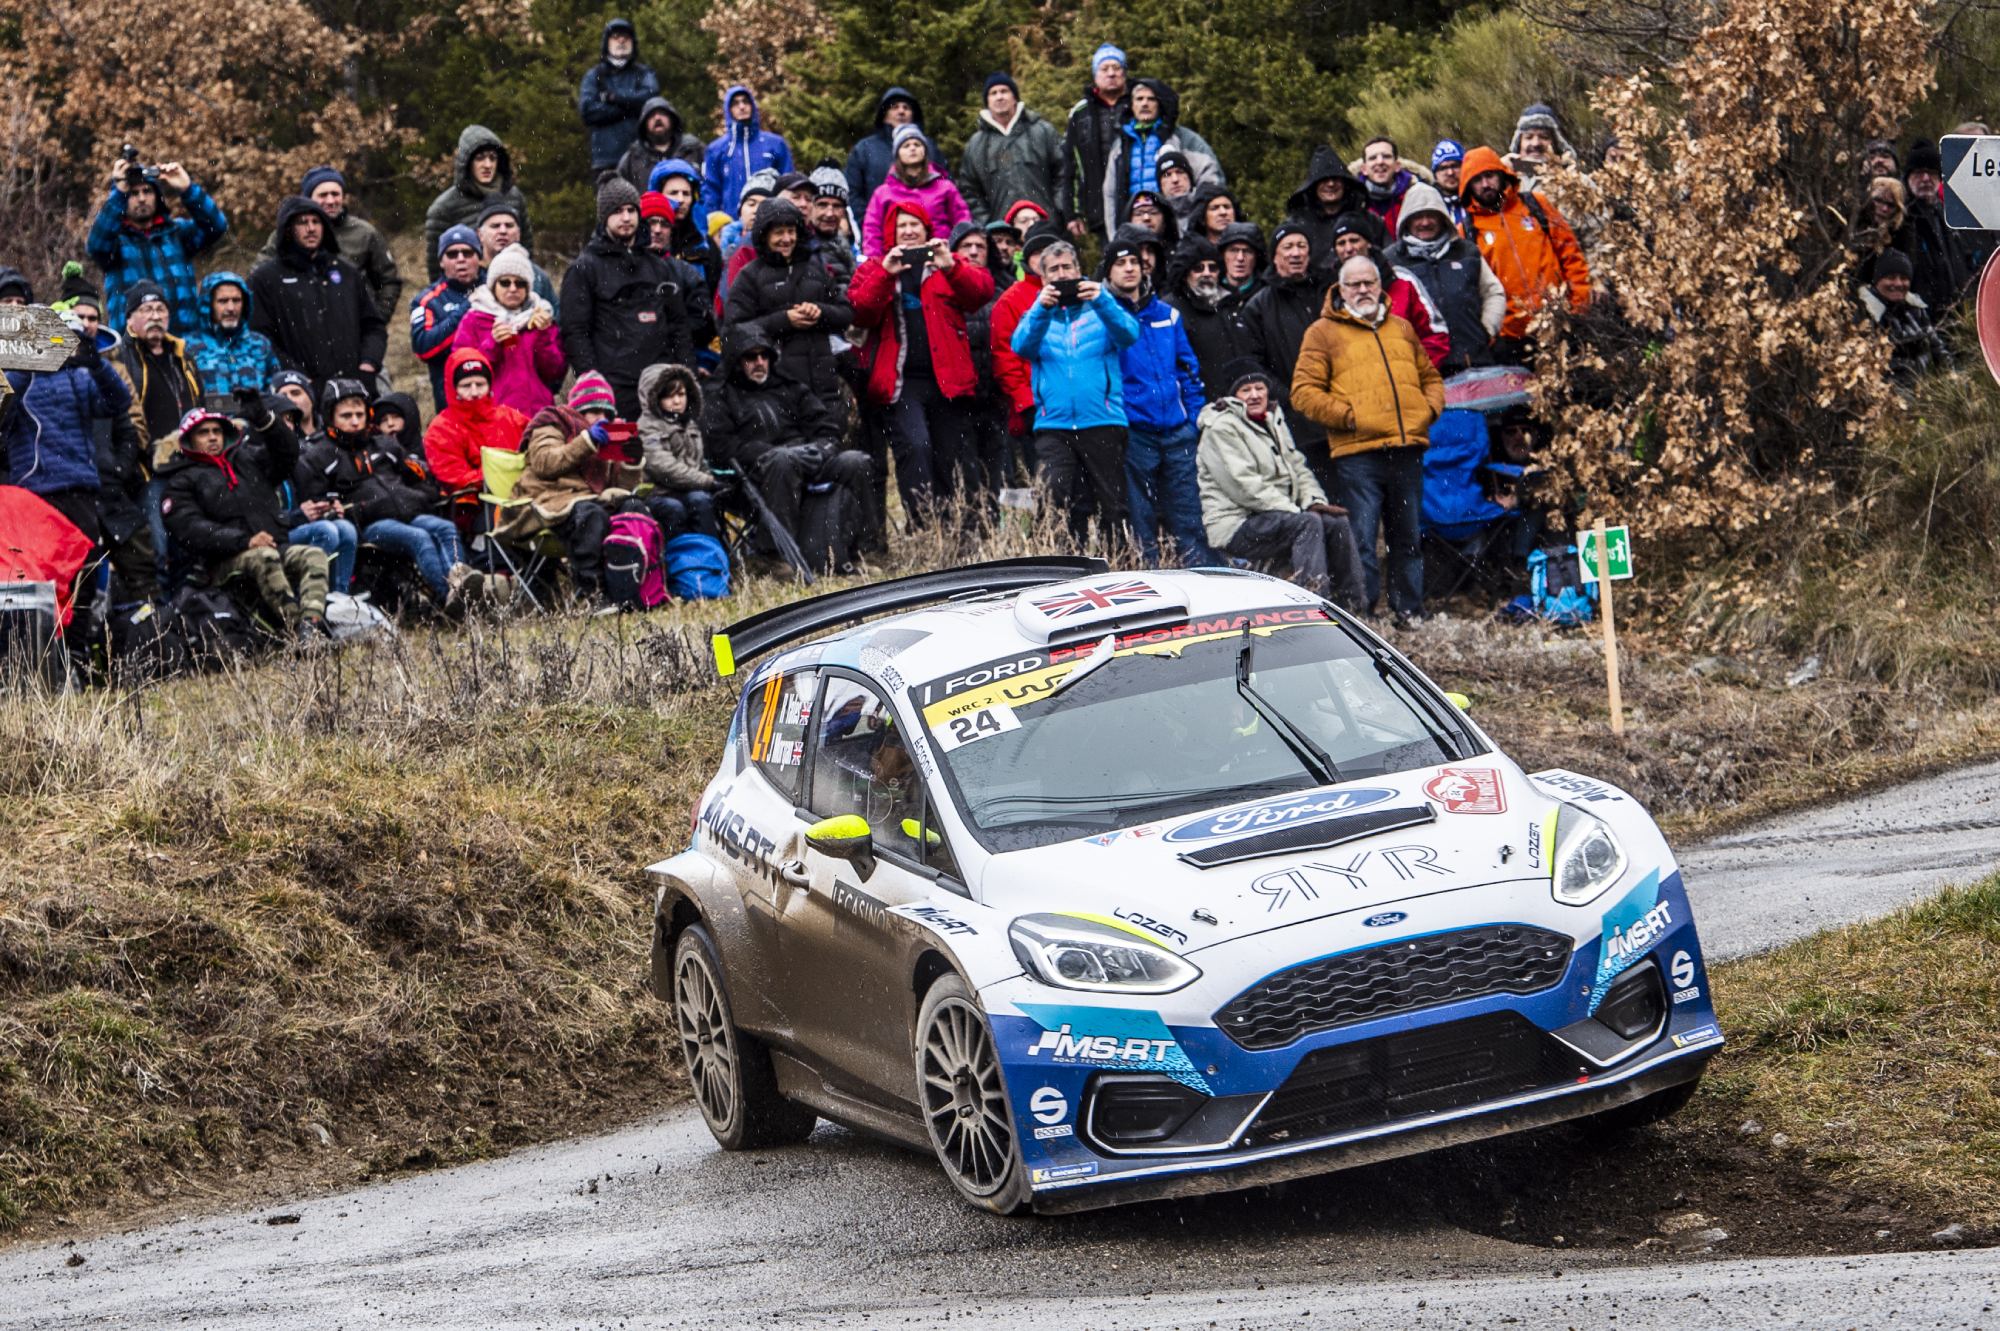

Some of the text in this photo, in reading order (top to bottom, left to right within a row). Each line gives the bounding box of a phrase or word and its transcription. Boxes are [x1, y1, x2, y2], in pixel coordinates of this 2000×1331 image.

[1973, 152, 2000, 177] Le
[945, 609, 1329, 694] FORD PEFORMANCE
[751, 672, 784, 762] 24
[948, 697, 994, 716] WRC 2
[950, 709, 1001, 744] 24
[1209, 793, 1356, 835] Ford
[1617, 900, 1672, 958] MS-RT
[1053, 1034, 1177, 1062] MS-RT
